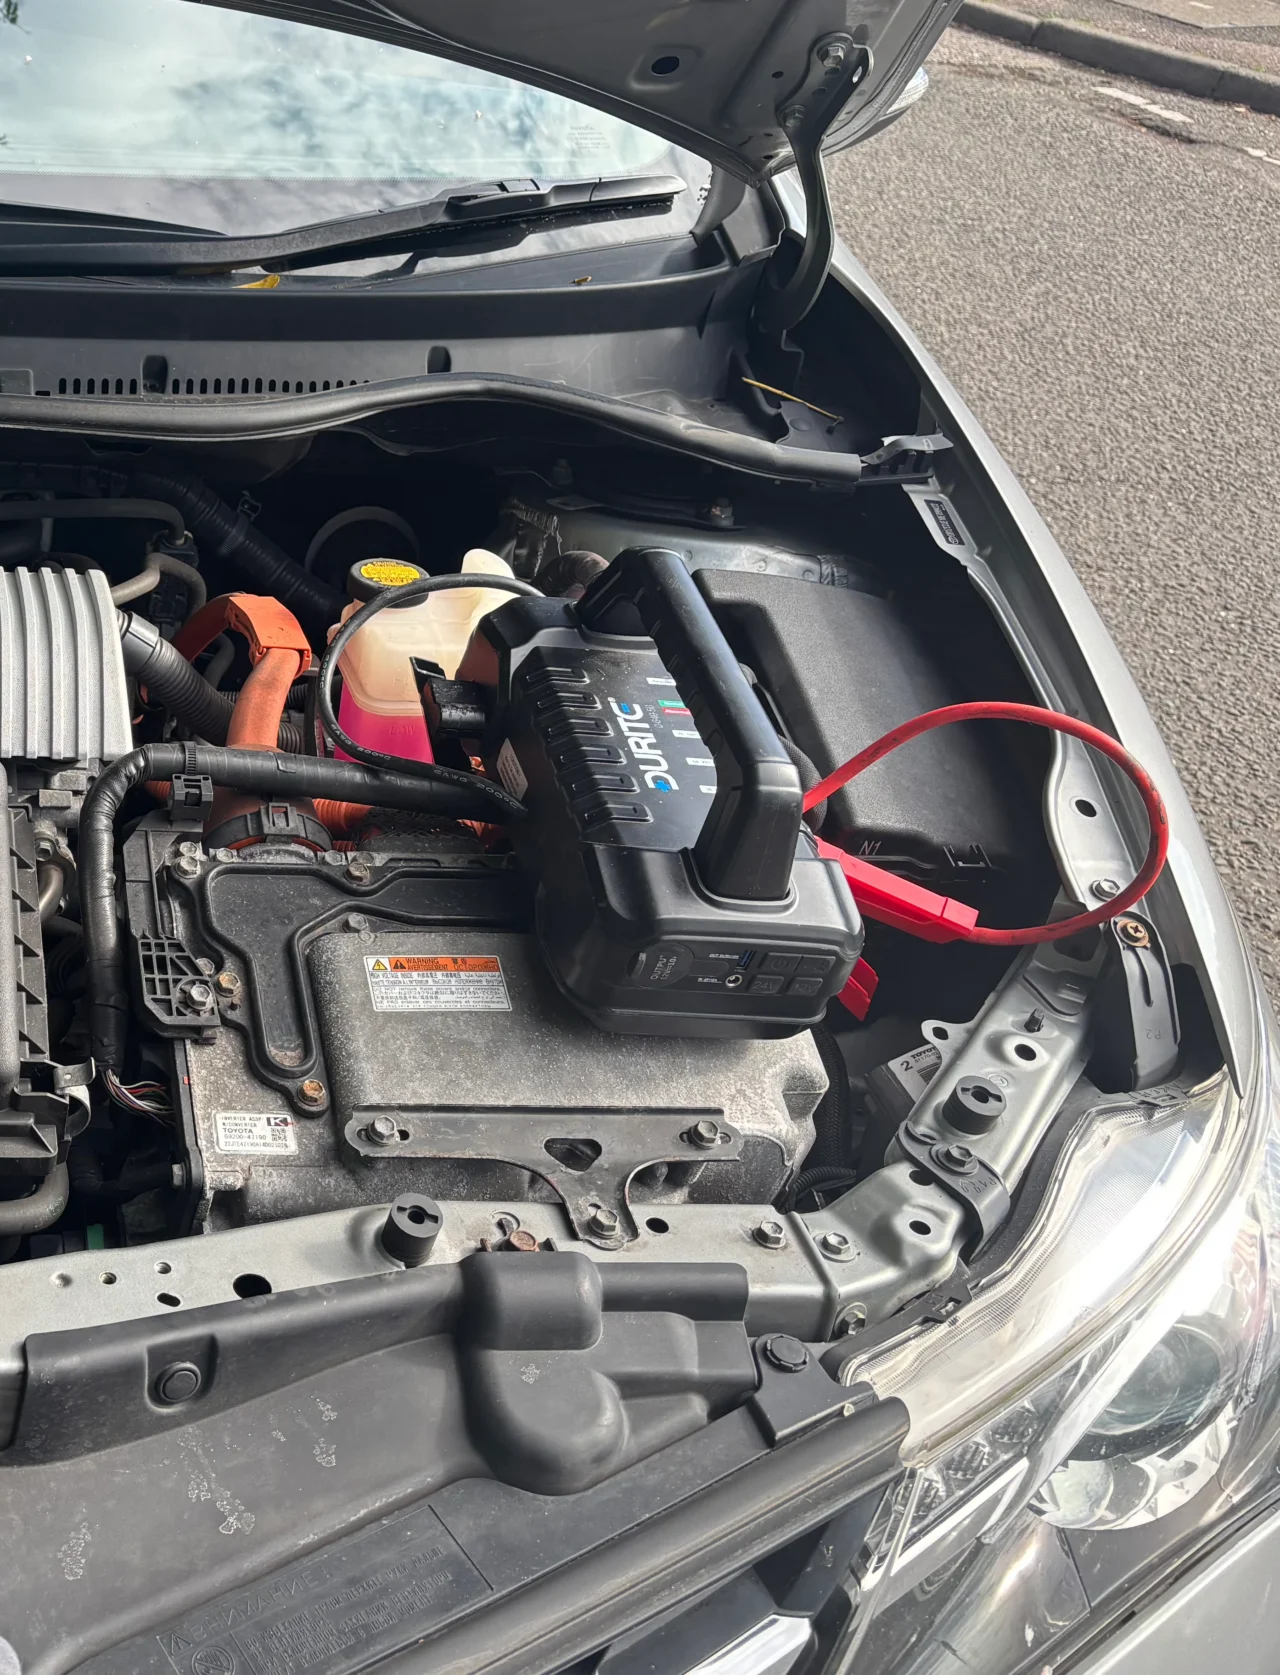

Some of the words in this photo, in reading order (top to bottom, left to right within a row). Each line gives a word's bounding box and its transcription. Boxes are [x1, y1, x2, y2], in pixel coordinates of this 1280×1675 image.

[609, 699, 680, 791] DURITE
[900, 1060, 913, 1072] 2
[188, 1569, 318, 1642] ВНИМАНИЕ
